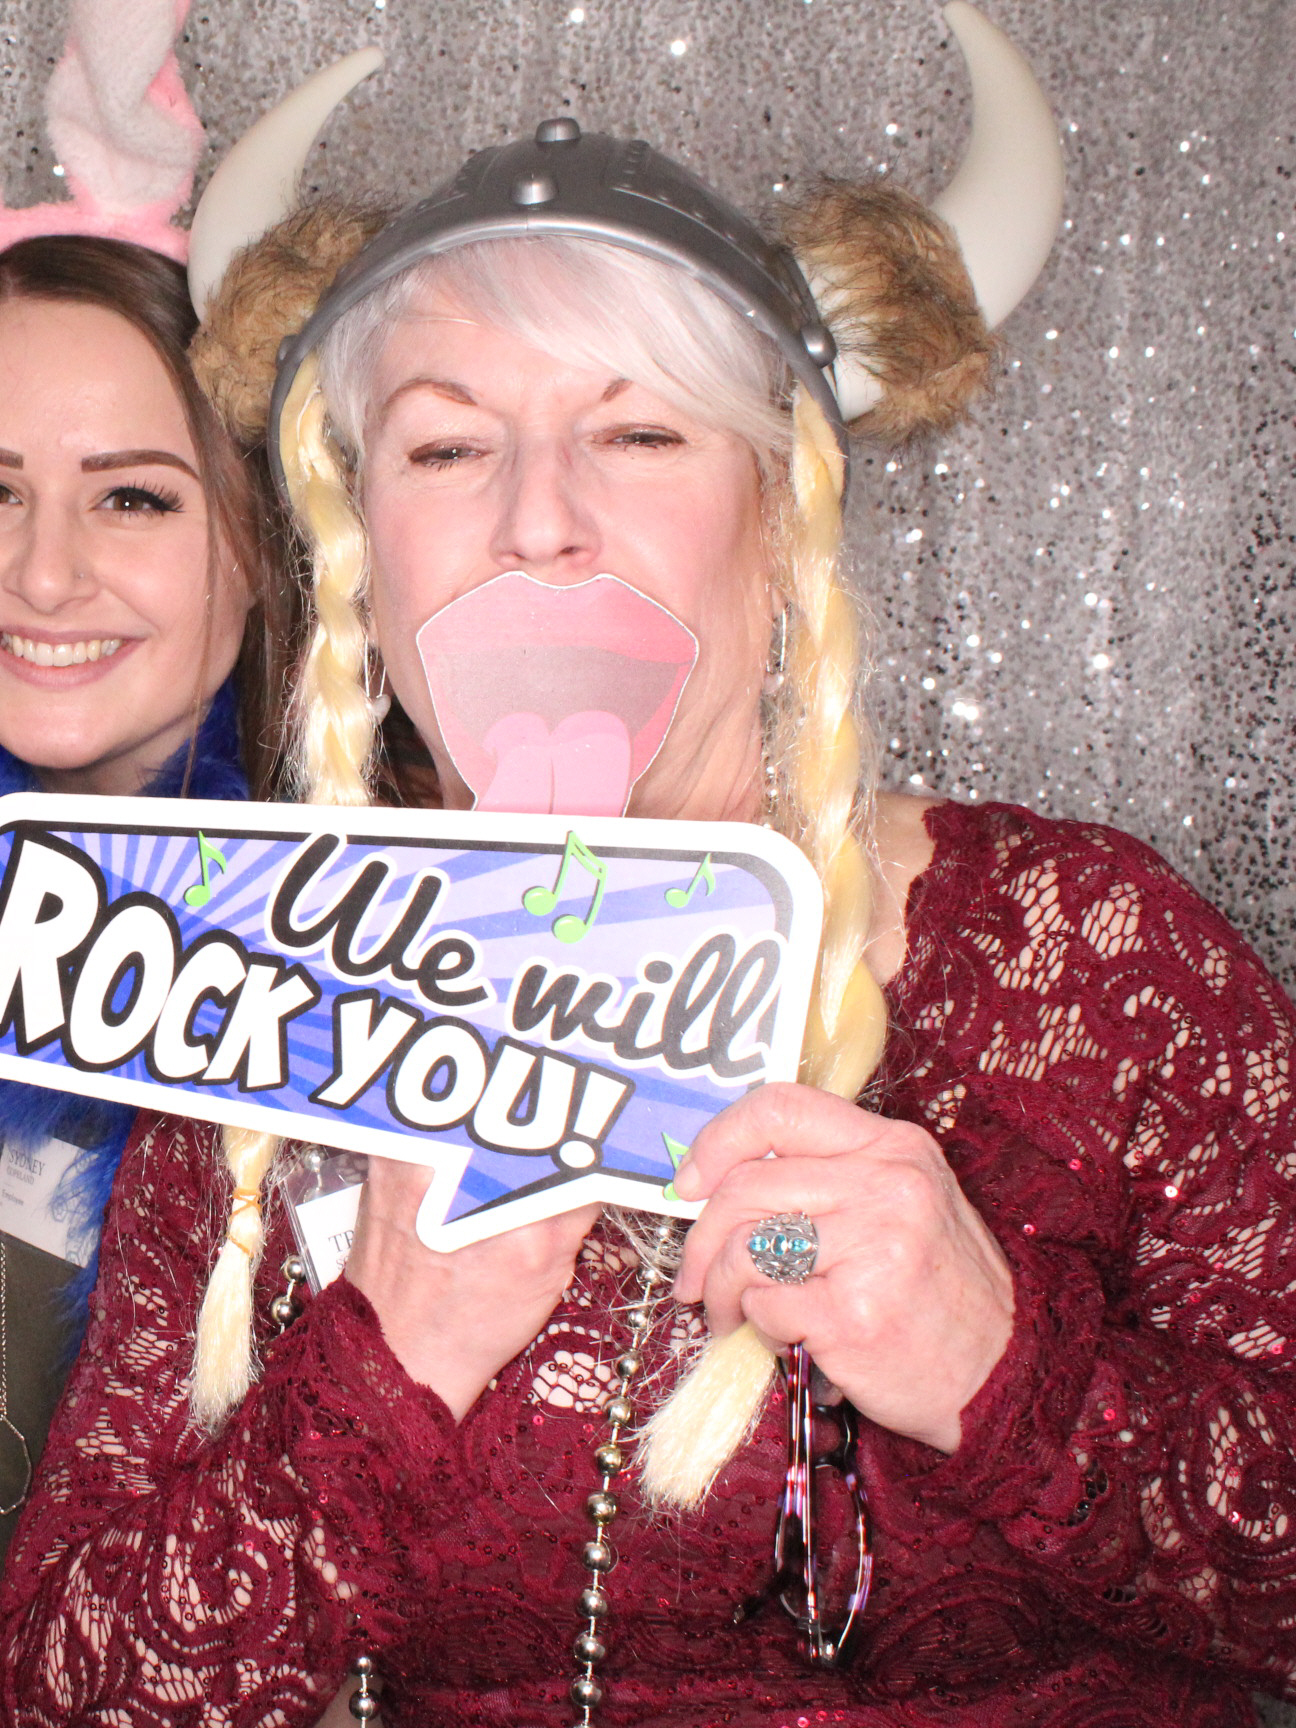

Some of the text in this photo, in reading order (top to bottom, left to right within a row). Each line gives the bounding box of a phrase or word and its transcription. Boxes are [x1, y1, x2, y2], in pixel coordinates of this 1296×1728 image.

[269, 832, 782, 1080] We will
[8, 1149, 46, 1176] SYDNEY
[309, 990, 635, 1171] YOU!
